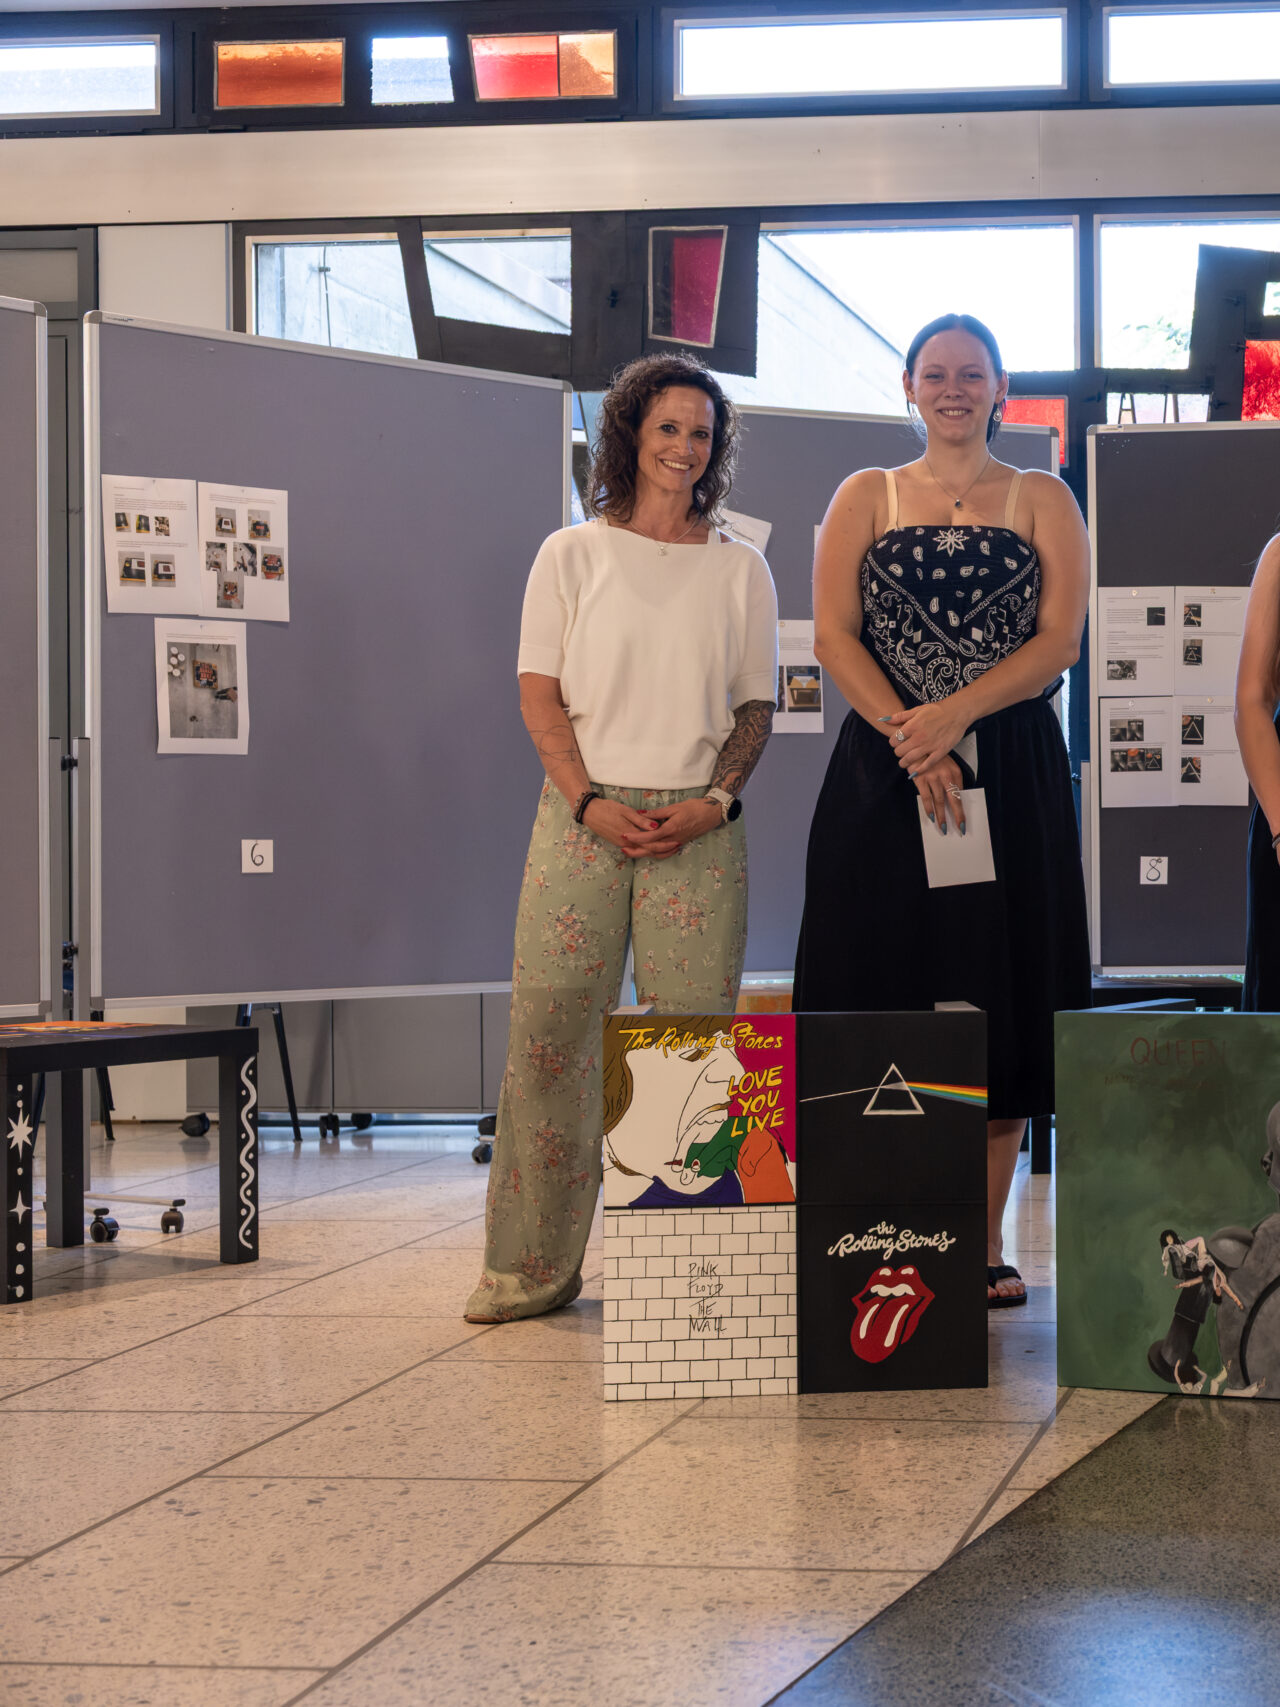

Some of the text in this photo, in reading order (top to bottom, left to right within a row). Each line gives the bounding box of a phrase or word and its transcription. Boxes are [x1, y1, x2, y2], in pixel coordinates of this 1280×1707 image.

[250, 842, 265, 867] 6
[1146, 858, 1161, 882] 8
[618, 1022, 783, 1061] The Rolling Stones
[1130, 1036, 1227, 1067] QUEEN
[727, 1065, 784, 1097] LOVE
[738, 1089, 780, 1117] YOU
[730, 1107, 785, 1138] LIVE
[827, 1229, 957, 1261] Rolling Stones
[688, 1260, 719, 1280] PINK
[687, 1277, 724, 1298] FLOYD
[689, 1300, 717, 1316] THE
[688, 1314, 728, 1333] WALL
